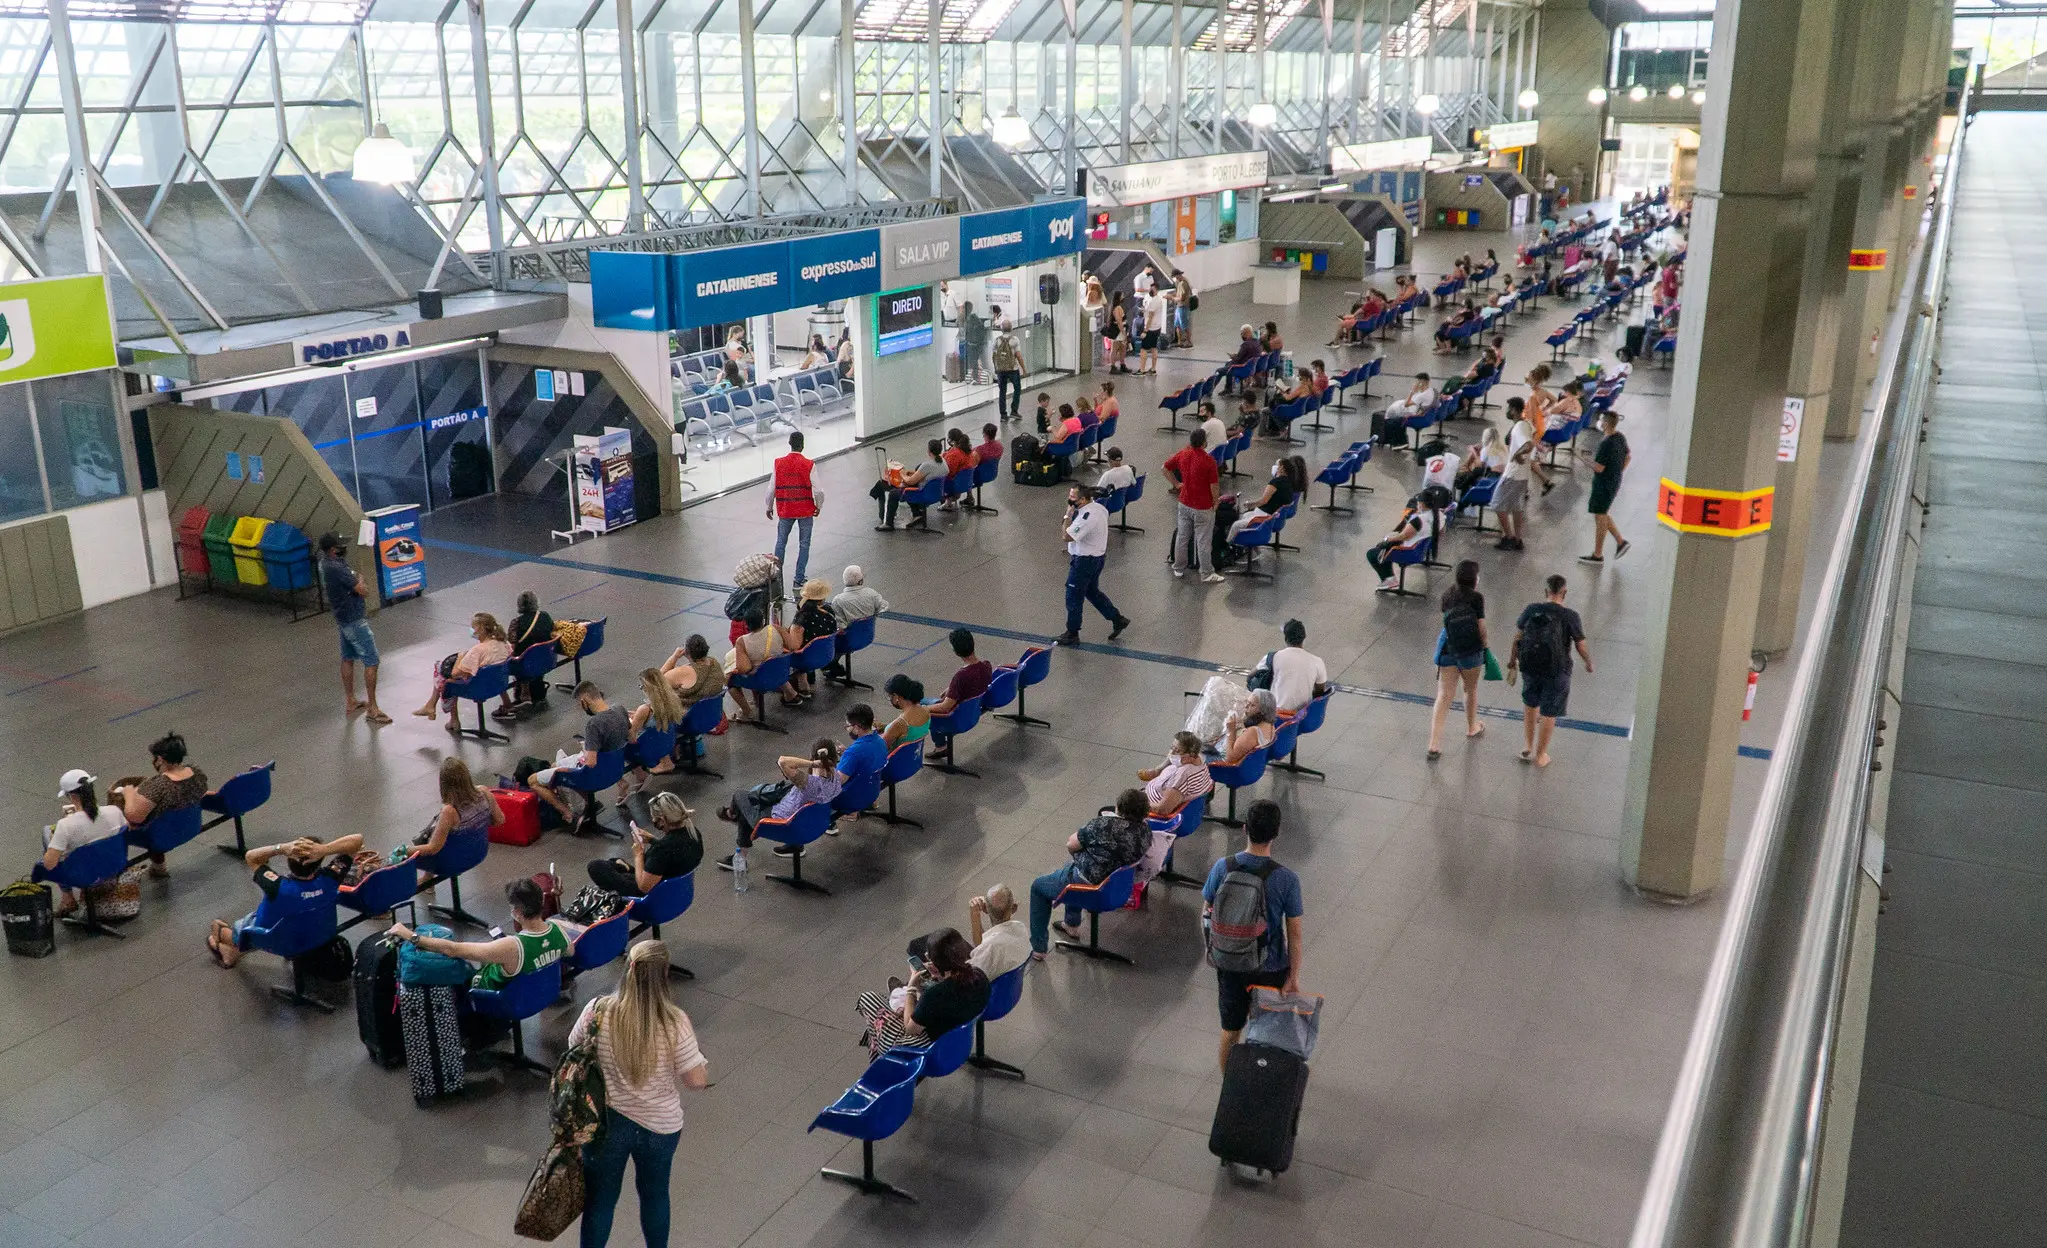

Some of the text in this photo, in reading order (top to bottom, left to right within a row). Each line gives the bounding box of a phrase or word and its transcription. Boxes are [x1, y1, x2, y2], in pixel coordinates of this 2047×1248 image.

[1212, 164, 1238, 182] PORTO
[1239, 161, 1267, 180] ALEGRE
[1048, 215, 1074, 244] 1001
[972, 231, 1023, 250] CATARINENSE
[900, 241, 950, 265] SALA VIP
[696, 272, 778, 297] CATARINENSE
[892, 295, 922, 315] DIRETO
[395, 330, 410, 347] A
[431, 410, 479, 430] PORTÃO A
[582, 488, 599, 498] 24H
[1666, 490, 1763, 526] E E E
